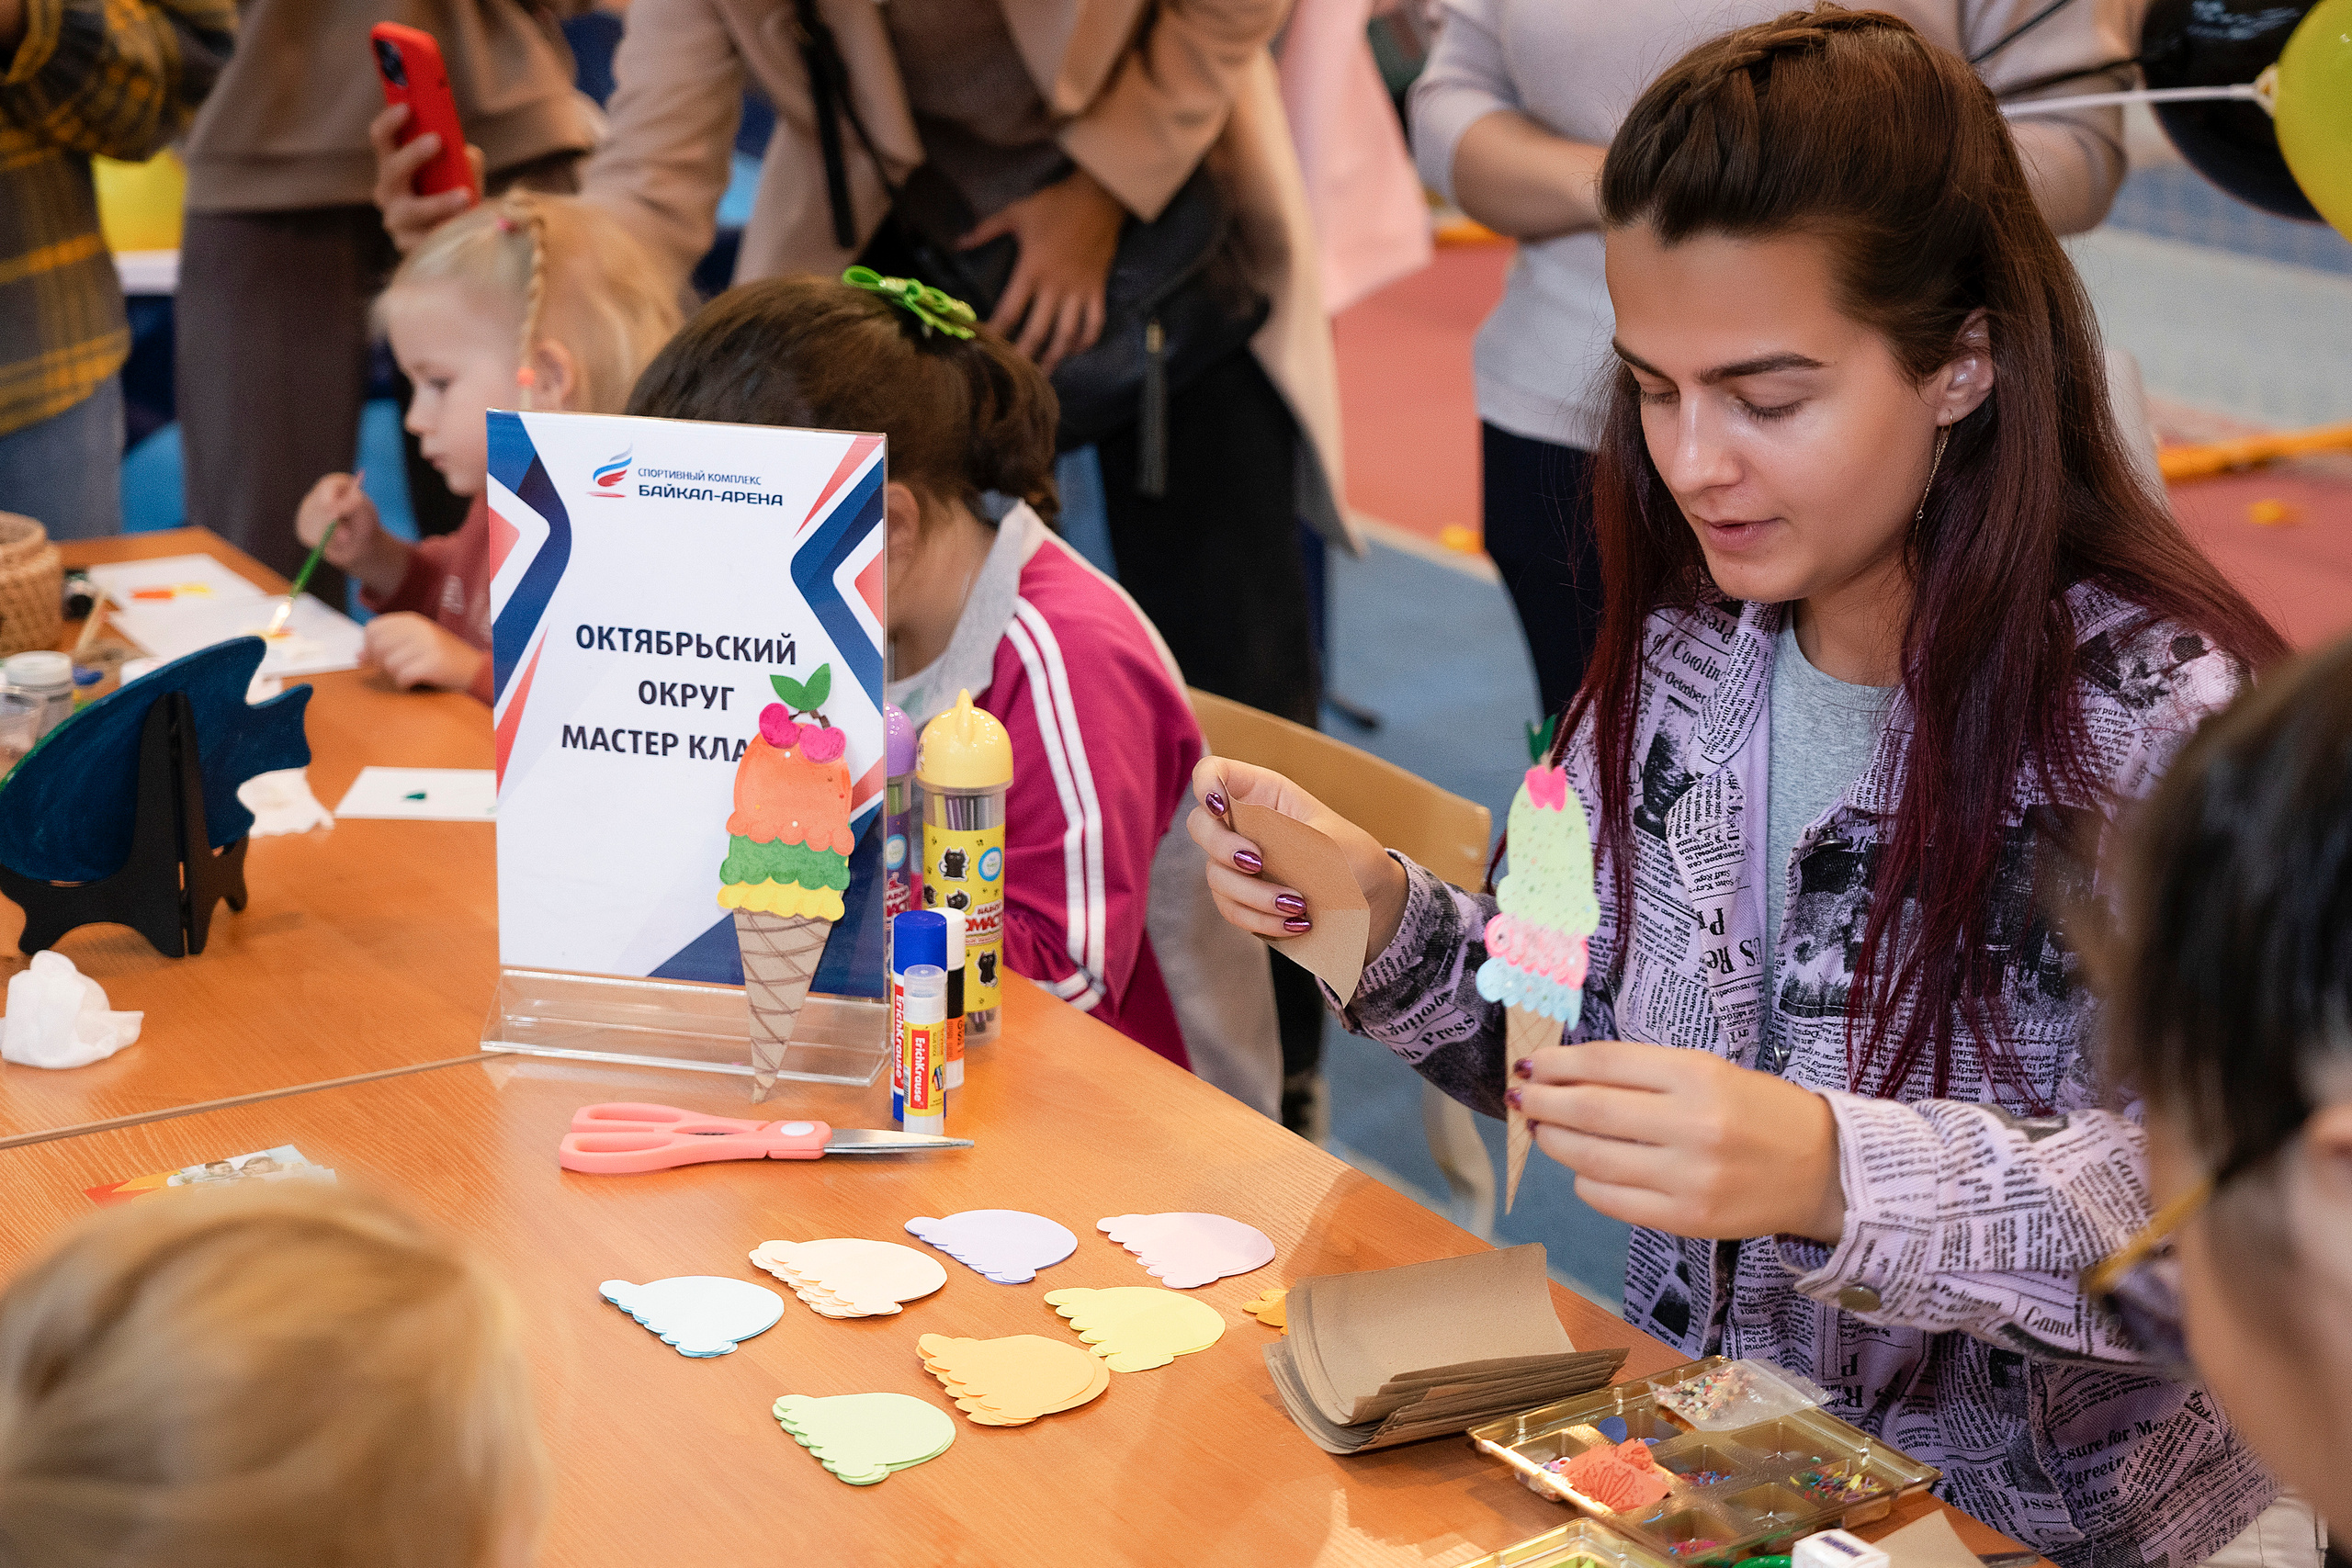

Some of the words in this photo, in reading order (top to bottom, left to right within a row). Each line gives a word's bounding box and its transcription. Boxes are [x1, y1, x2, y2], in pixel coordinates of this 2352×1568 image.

[638, 468, 706, 482] СПОРТИВНЫЙ
[707, 473, 762, 486] КОМПЛЕКС
[639, 484, 783, 506] БАЙКАЛ-АРЕНА
[576, 625, 797, 665] ОКТЯБРЬСКИЙ
[638, 681, 735, 710] ОКРУГ
[561, 725, 679, 756] МАСТЕР
[689, 735, 749, 762] КЛА
[913, 1037, 926, 1102] ErichKrause
